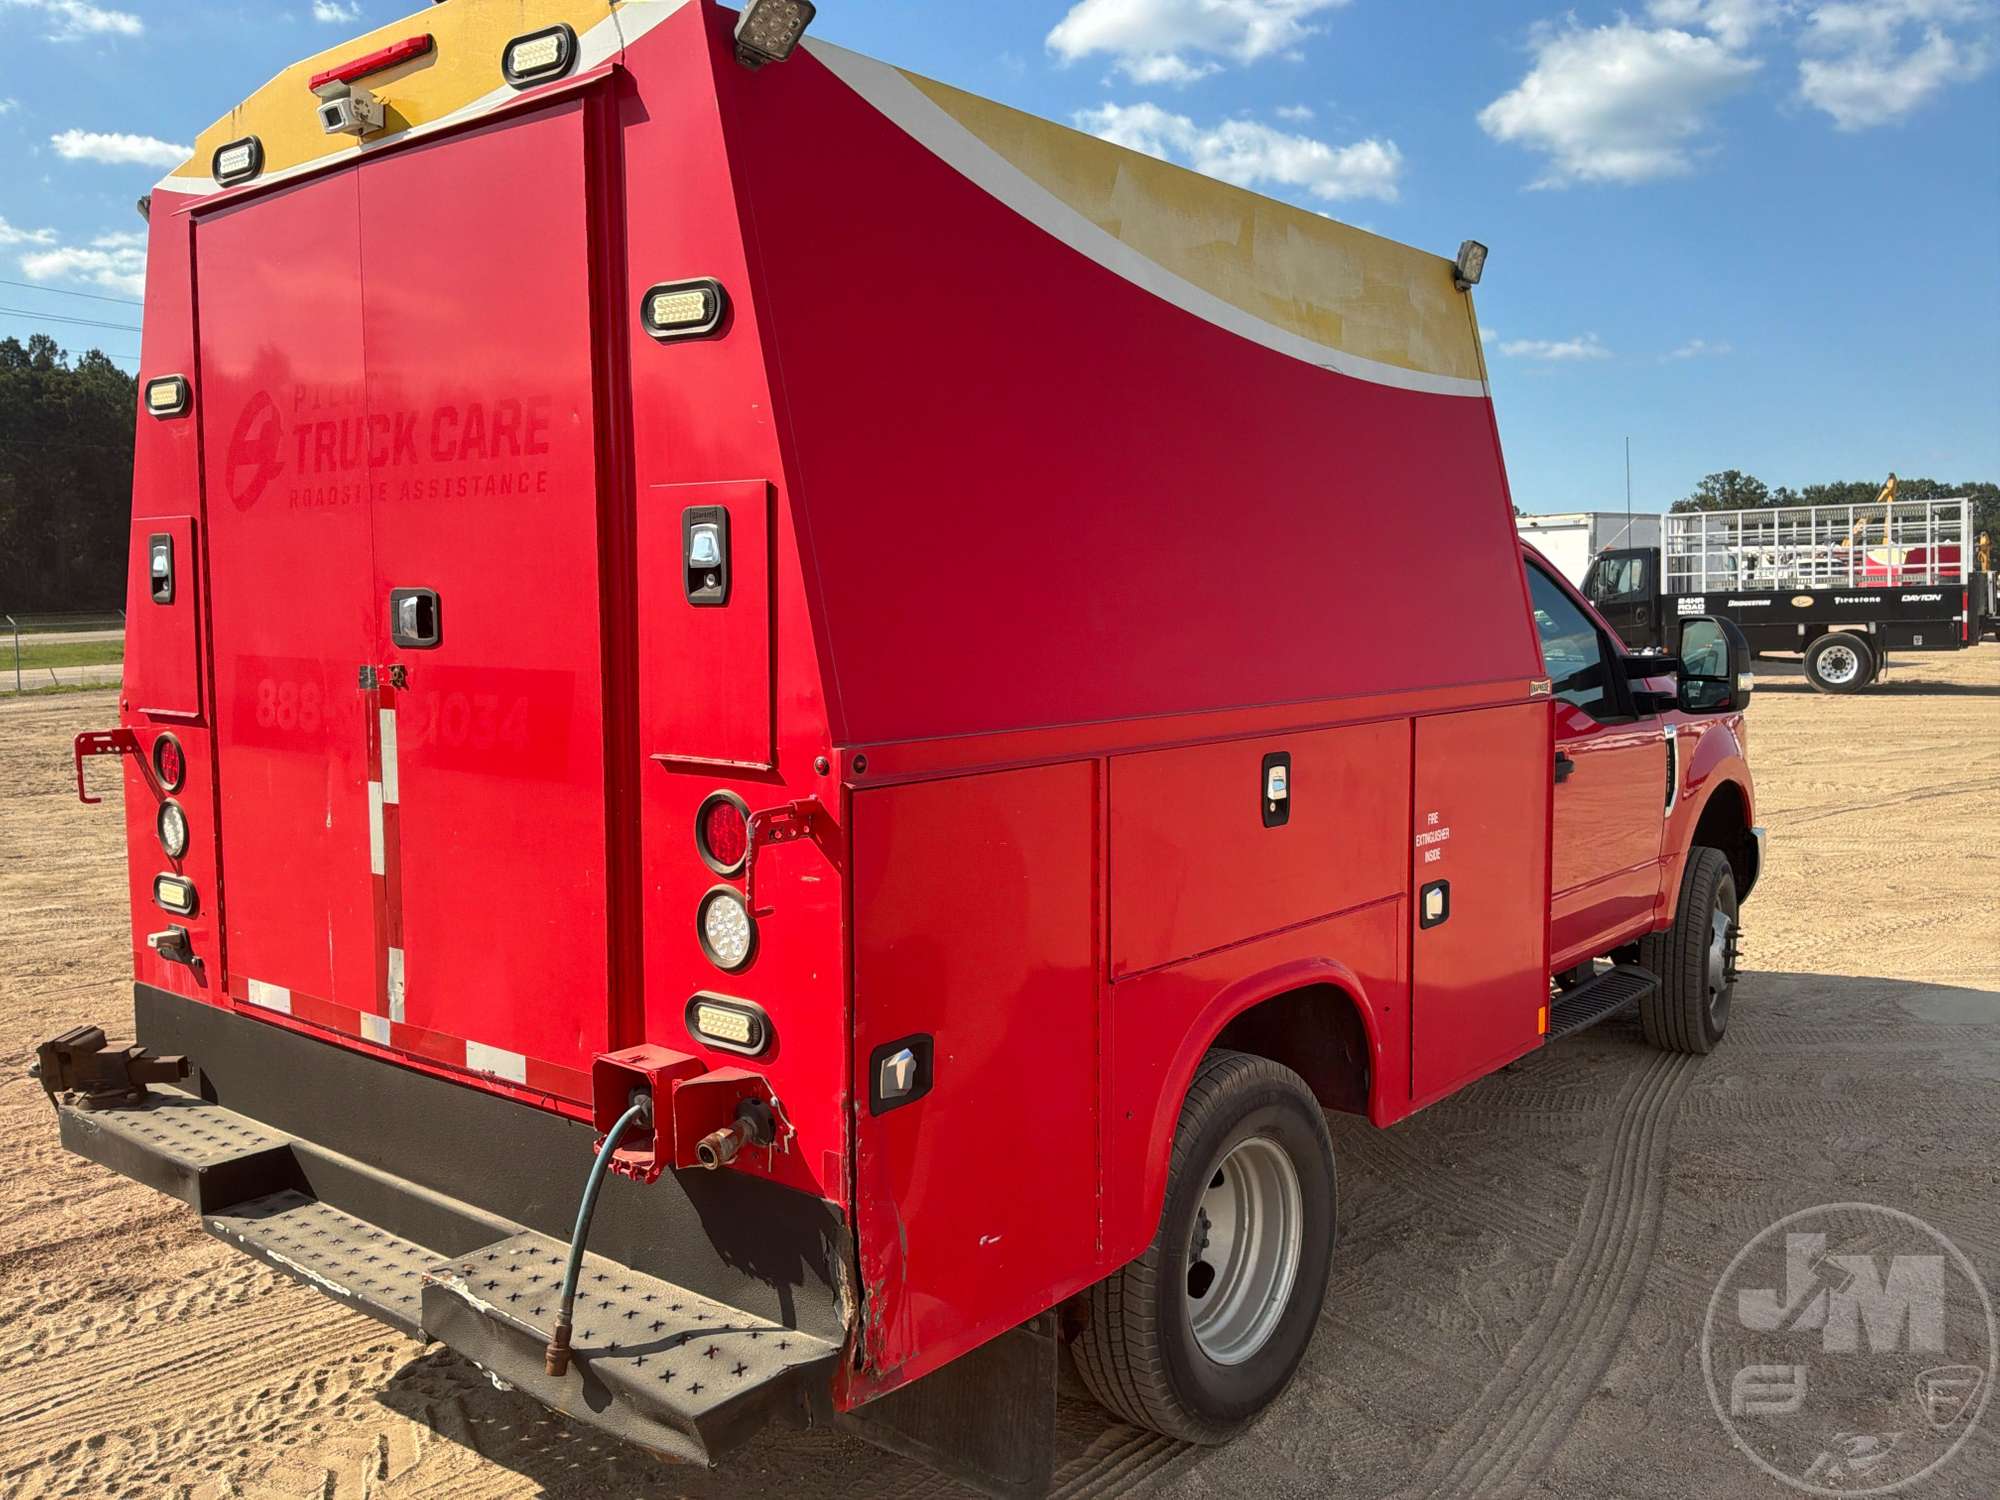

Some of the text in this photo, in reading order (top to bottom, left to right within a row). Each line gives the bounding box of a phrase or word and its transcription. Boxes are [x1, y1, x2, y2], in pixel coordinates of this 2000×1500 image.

[293, 396, 549, 474] TRUCK CARE
[289, 471, 548, 509] ROADSIE ASSISTANCE
[1834, 596, 1881, 605] Firestone
[1901, 594, 1942, 602] DAYTON
[1428, 812, 1439, 825] FIRE
[1416, 827, 1450, 847] EXTINGUISHER
[1425, 848, 1441, 863] INSIDE
